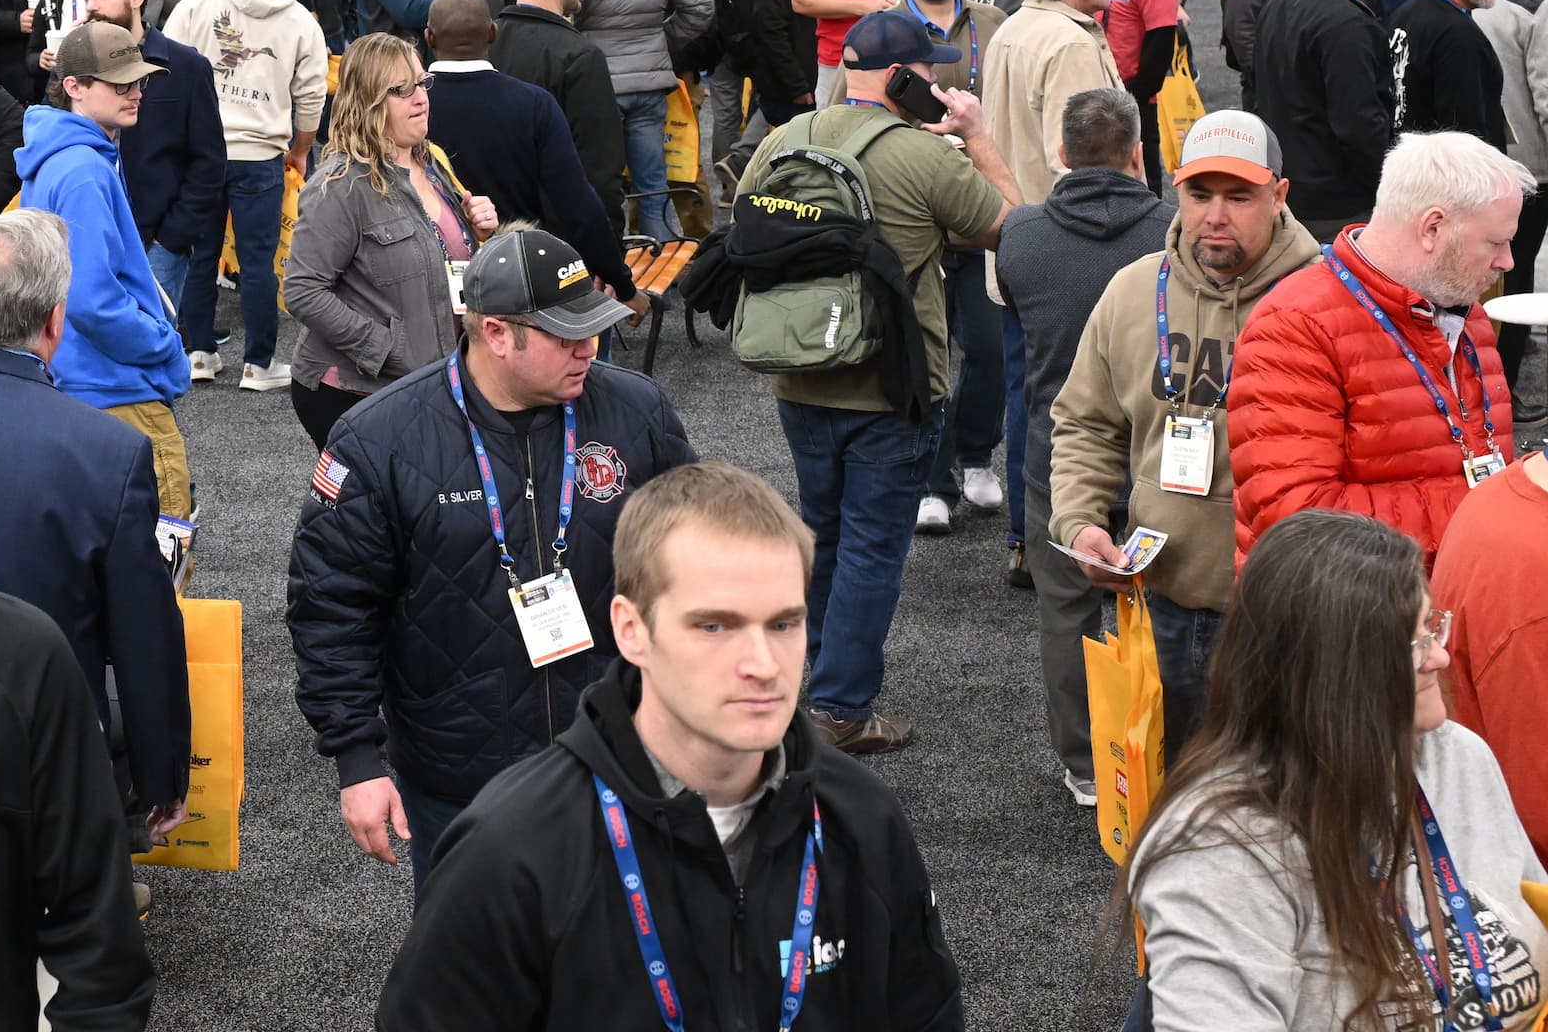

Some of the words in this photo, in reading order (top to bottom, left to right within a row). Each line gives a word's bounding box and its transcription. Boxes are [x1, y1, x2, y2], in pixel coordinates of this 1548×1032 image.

[1193, 125, 1257, 146] CATERPILLAR
[748, 194, 822, 221] Wheeler
[1355, 288, 1376, 311] BOSCH
[825, 305, 842, 348] CATERPILLAR
[438, 493, 449, 504] B.
[450, 489, 483, 502] SILVER
[491, 506, 502, 533] BOSCH
[607, 805, 627, 849] BOSCH
[802, 863, 817, 906] BOSCH
[1437, 855, 1458, 893] BOSCH
[630, 892, 651, 936] BOSCH
[1464, 931, 1483, 969] BOSCH
[789, 950, 804, 993] BOSCH
[656, 978, 677, 1019] BOSCH
